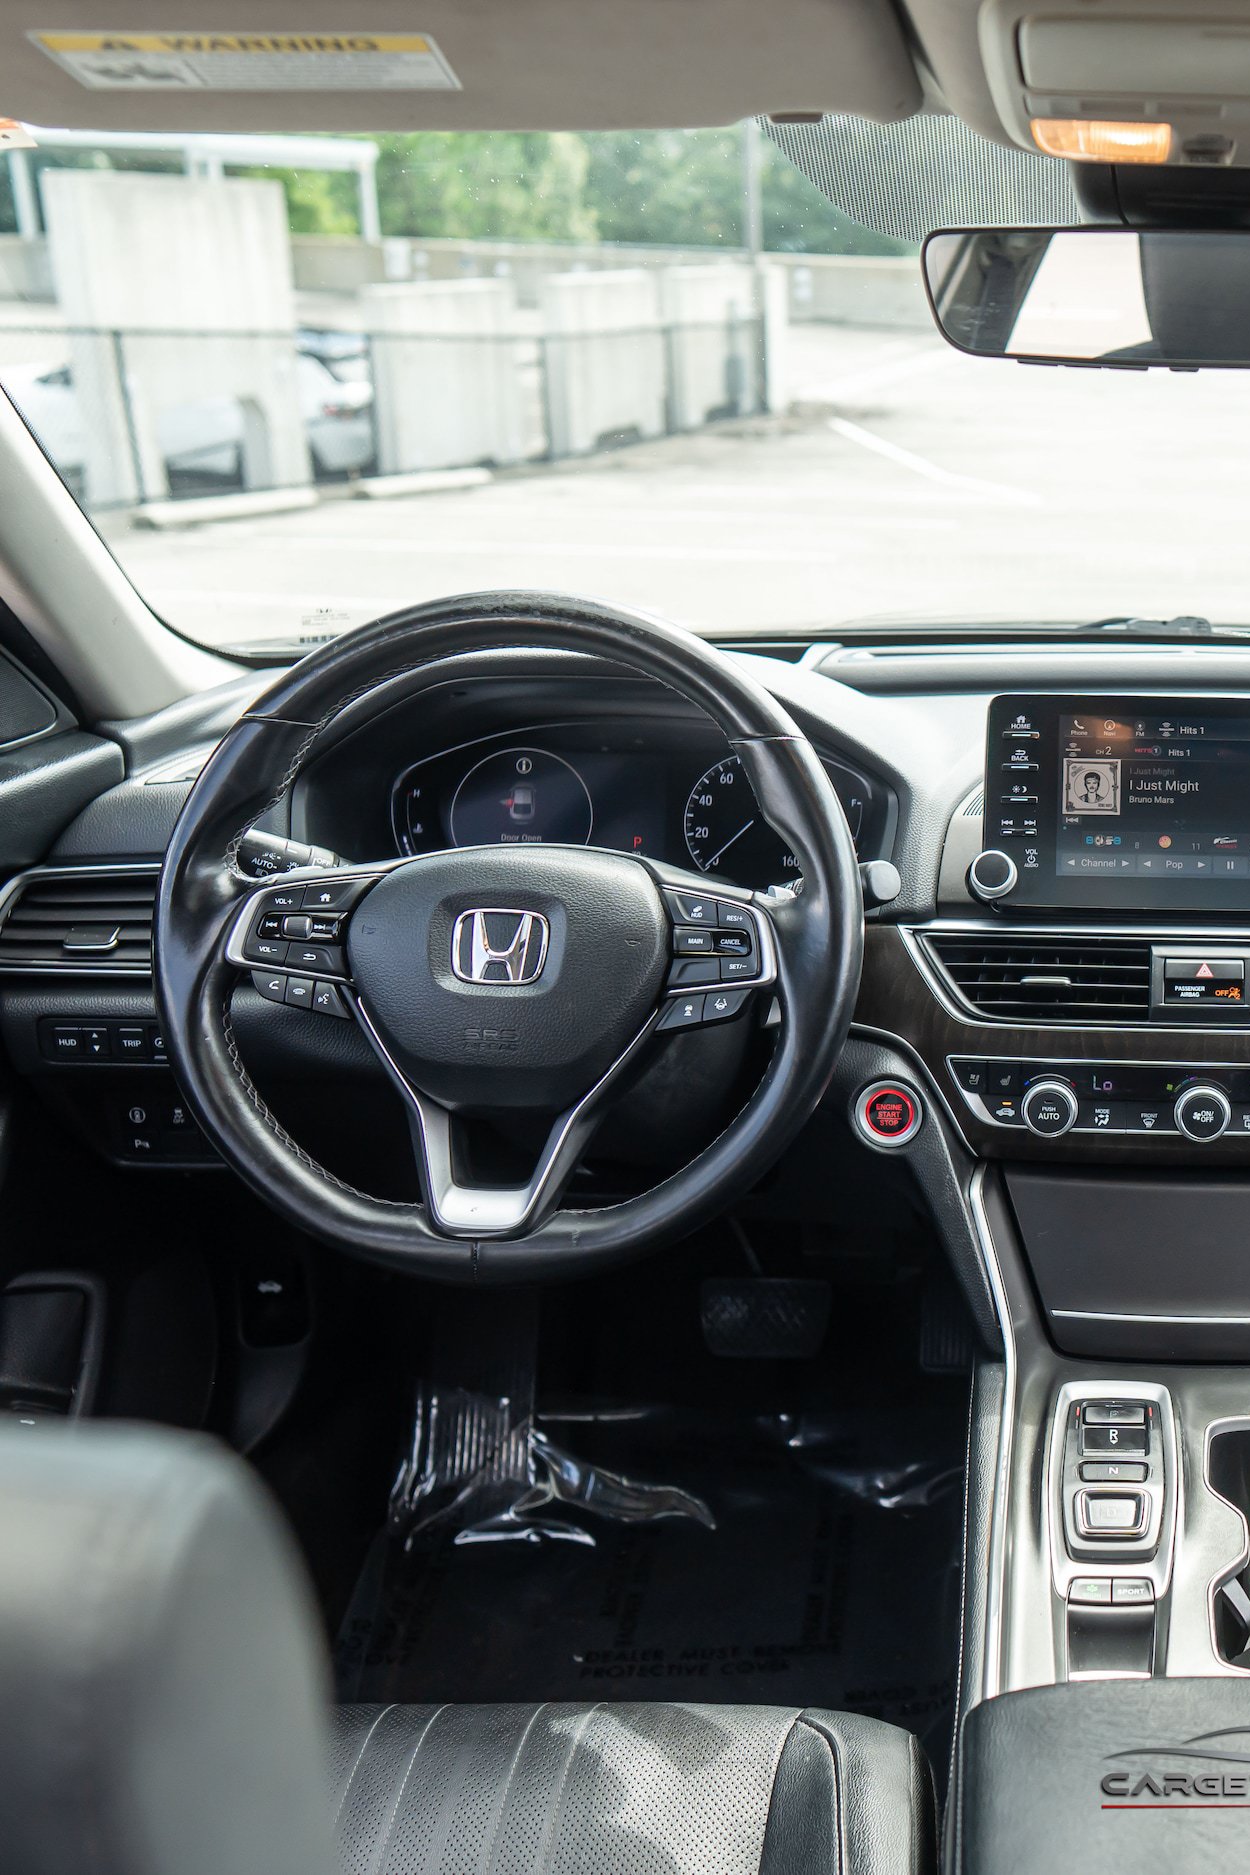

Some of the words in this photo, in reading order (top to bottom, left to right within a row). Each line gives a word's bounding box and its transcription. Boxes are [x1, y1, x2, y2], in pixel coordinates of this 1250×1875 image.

[159, 36, 378, 53] WARNING
[1070, 729, 1088, 737] Phone
[1179, 726, 1198, 735] Hits
[1199, 726, 1205, 735] 1
[1105, 746, 1112, 756] 2
[1168, 749, 1185, 757] Hits
[1186, 749, 1191, 757] 1
[719, 773, 733, 785] 60
[1135, 780, 1162, 792] Just
[1165, 780, 1200, 794] Might
[413, 788, 420, 798] H
[698, 795, 713, 807] 40
[1129, 795, 1152, 804] Bruno
[1154, 796, 1175, 804] Mars
[695, 827, 709, 838] 20
[500, 833, 519, 842] Door
[521, 833, 542, 843] Open
[633, 836, 642, 849] P
[1192, 843, 1200, 851] 11
[251, 857, 274, 869] AUTO
[783, 856, 800, 867] 160
[1080, 858, 1117, 868] Channel
[1165, 861, 1184, 870] Pop
[1215, 989, 1229, 997] OFF
[463, 1028, 518, 1042] SRS
[58, 1039, 77, 1047] HUD
[123, 1040, 142, 1048] TRIP
[1038, 1112, 1060, 1121] AUTO
[1110, 1429, 1119, 1440] R
[1108, 1467, 1119, 1475] N
[585, 1648, 664, 1664] DEALER
[680, 1646, 741, 1661] MUST
[579, 1662, 712, 1679] PROTECTIVE
[720, 1660, 790, 1677] COVER
